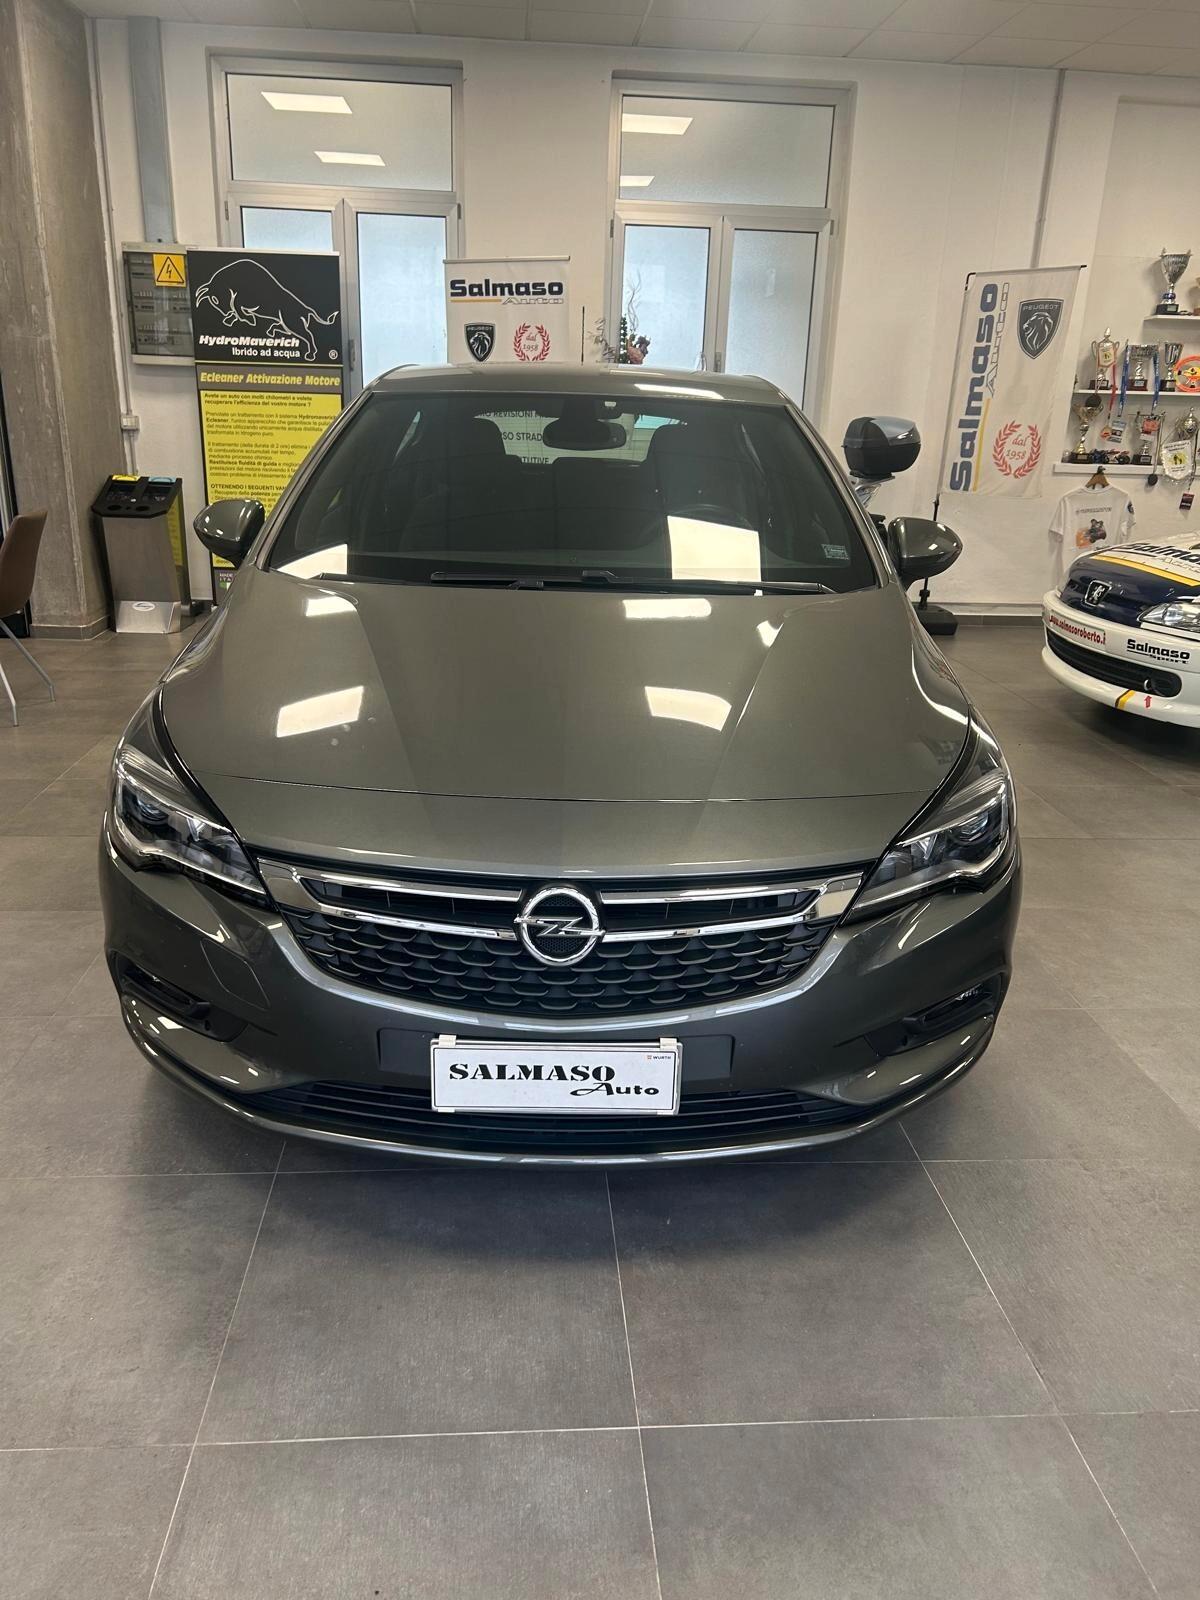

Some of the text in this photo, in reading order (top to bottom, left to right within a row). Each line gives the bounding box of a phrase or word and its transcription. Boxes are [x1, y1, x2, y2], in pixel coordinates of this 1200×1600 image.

[450, 278, 564, 297] Salmaso
[502, 297, 564, 305] Auto
[1022, 303, 1059, 311] PEUGEOT
[199, 335, 300, 348] HydroMaverich
[986, 282, 1010, 398] Auto
[232, 346, 301, 360] Ibrido ad acqua
[200, 371, 342, 387] Ecleaner Attivazione Motore
[949, 283, 999, 492] Salmaso
[516, 431, 543, 441] STRAD
[1012, 434, 1030, 447] dal
[1005, 449, 1027, 461] 1958
[1126, 638, 1190, 660] Salmaso
[449, 1063, 615, 1082] SALMASO
[569, 1082, 659, 1096] Auto
